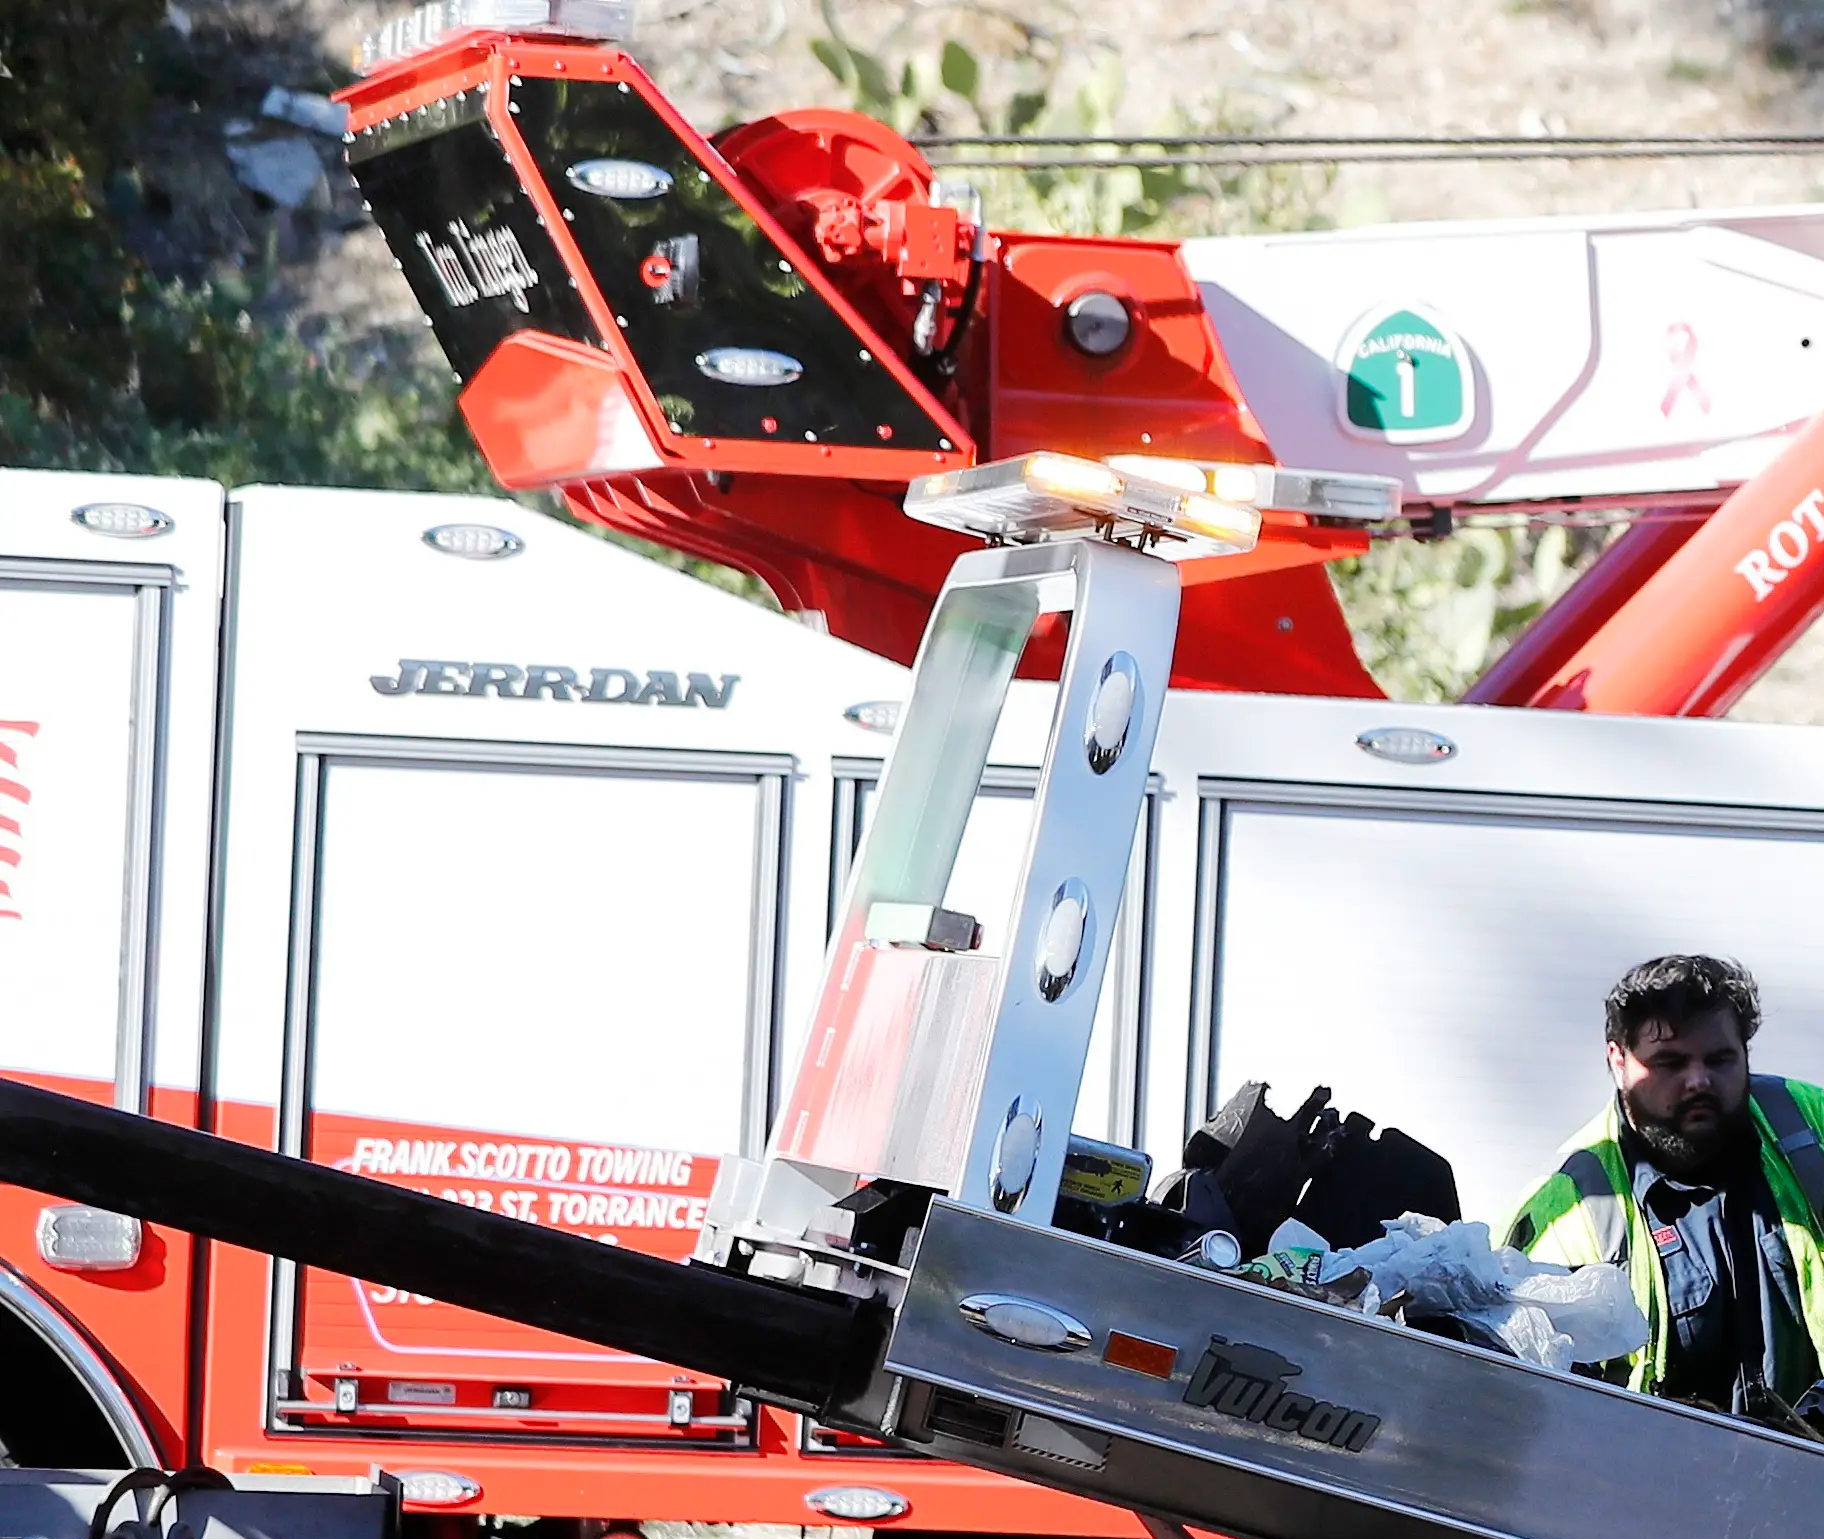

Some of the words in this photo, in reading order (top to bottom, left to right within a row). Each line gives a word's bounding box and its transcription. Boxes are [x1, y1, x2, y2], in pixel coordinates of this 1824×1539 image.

[1357, 333, 1453, 360] CALIFORNIA
[1396, 361, 1415, 418] 1
[369, 659, 741, 708] JERR-DAN
[351, 1137, 458, 1175] FRANK
[457, 1142, 572, 1180] SCOTTO
[577, 1148, 694, 1187] TOWING
[500, 1191, 540, 1225] ST.
[549, 1193, 709, 1230] TORRANCE
[1183, 1350, 1381, 1453] Vulcan
